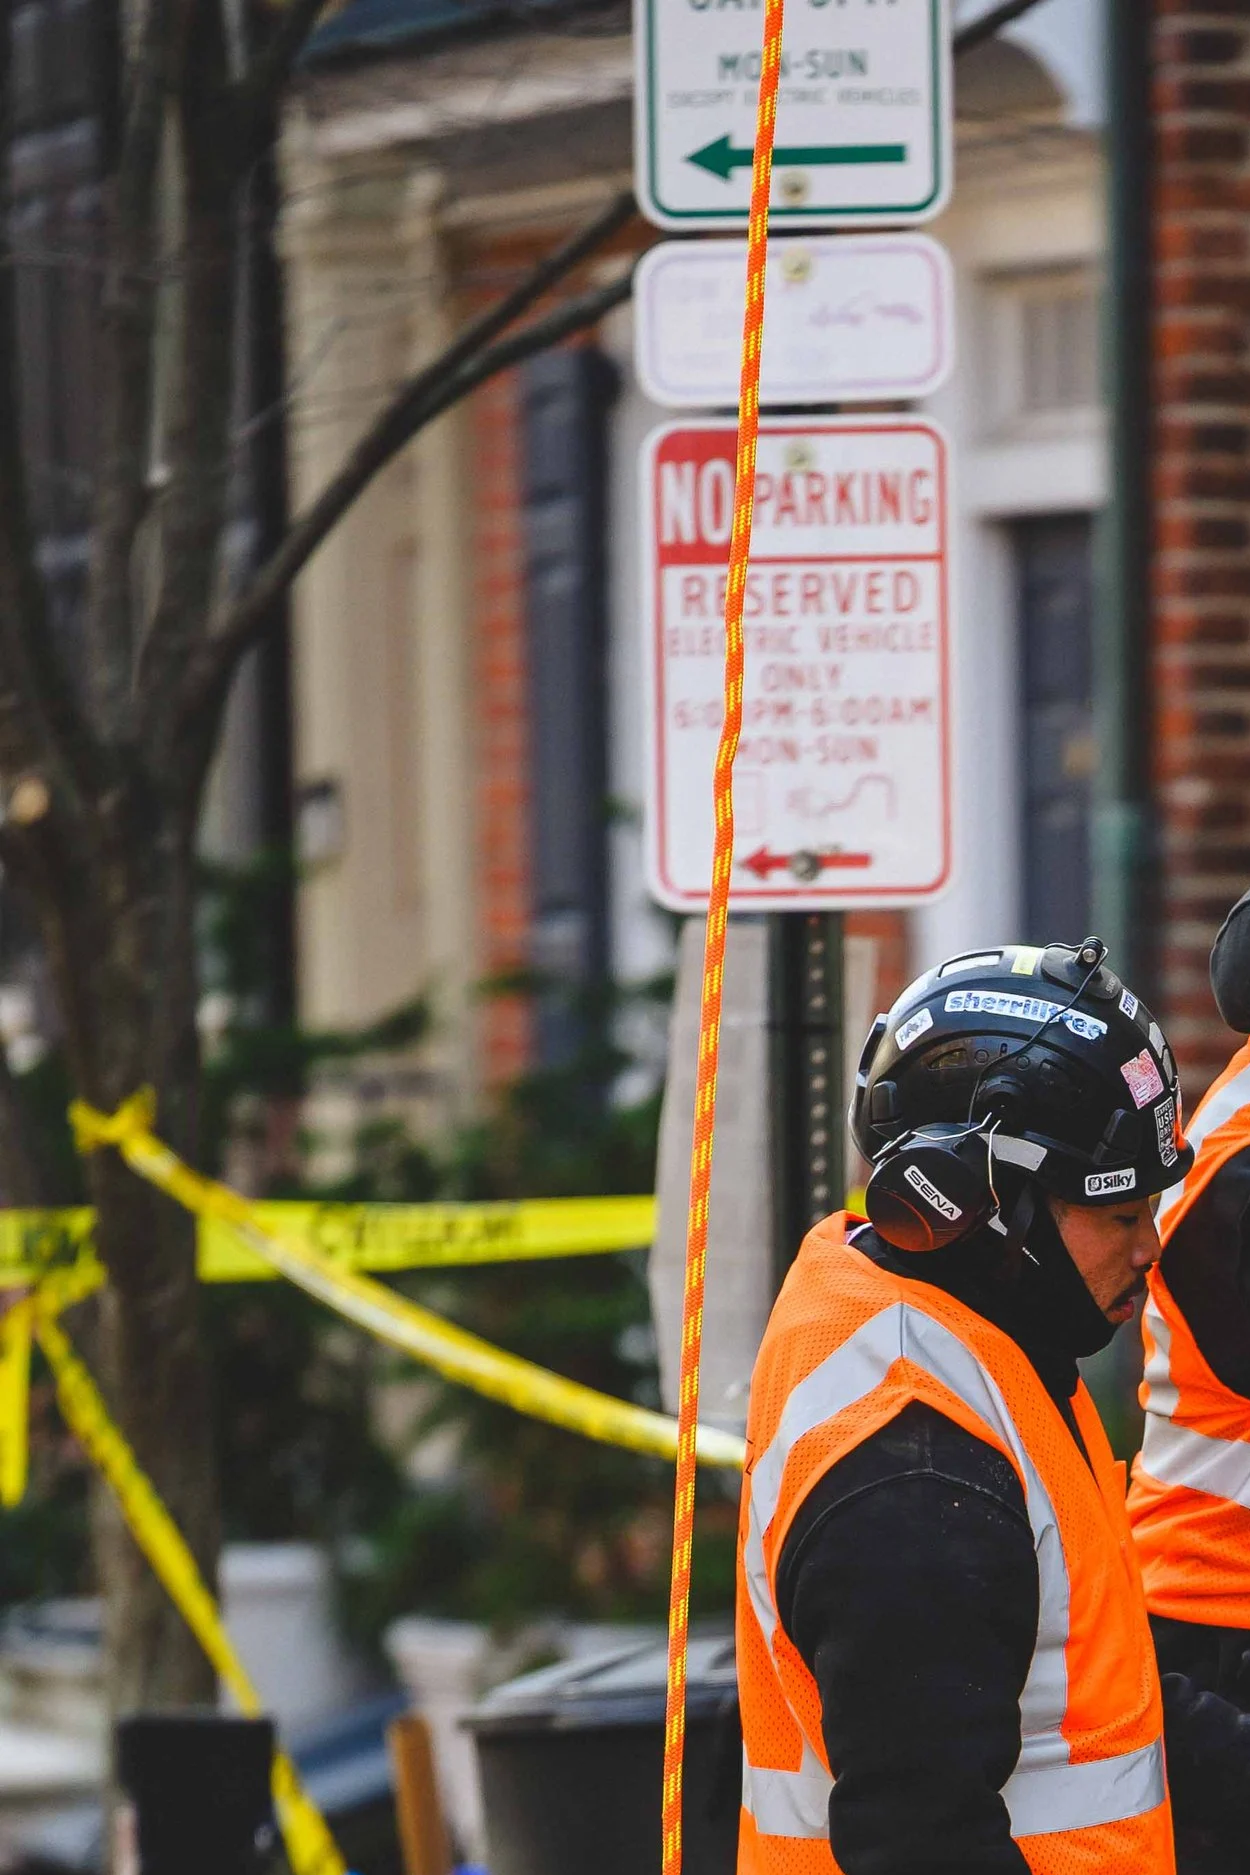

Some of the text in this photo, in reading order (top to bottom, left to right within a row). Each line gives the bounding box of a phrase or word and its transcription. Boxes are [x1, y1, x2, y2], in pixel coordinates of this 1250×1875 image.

[660, 458, 931, 546] NO PARKING
[1158, 1108, 1174, 1129] USE
[908, 1170, 955, 1218] SENA
[1103, 1174, 1133, 1189] Silky
